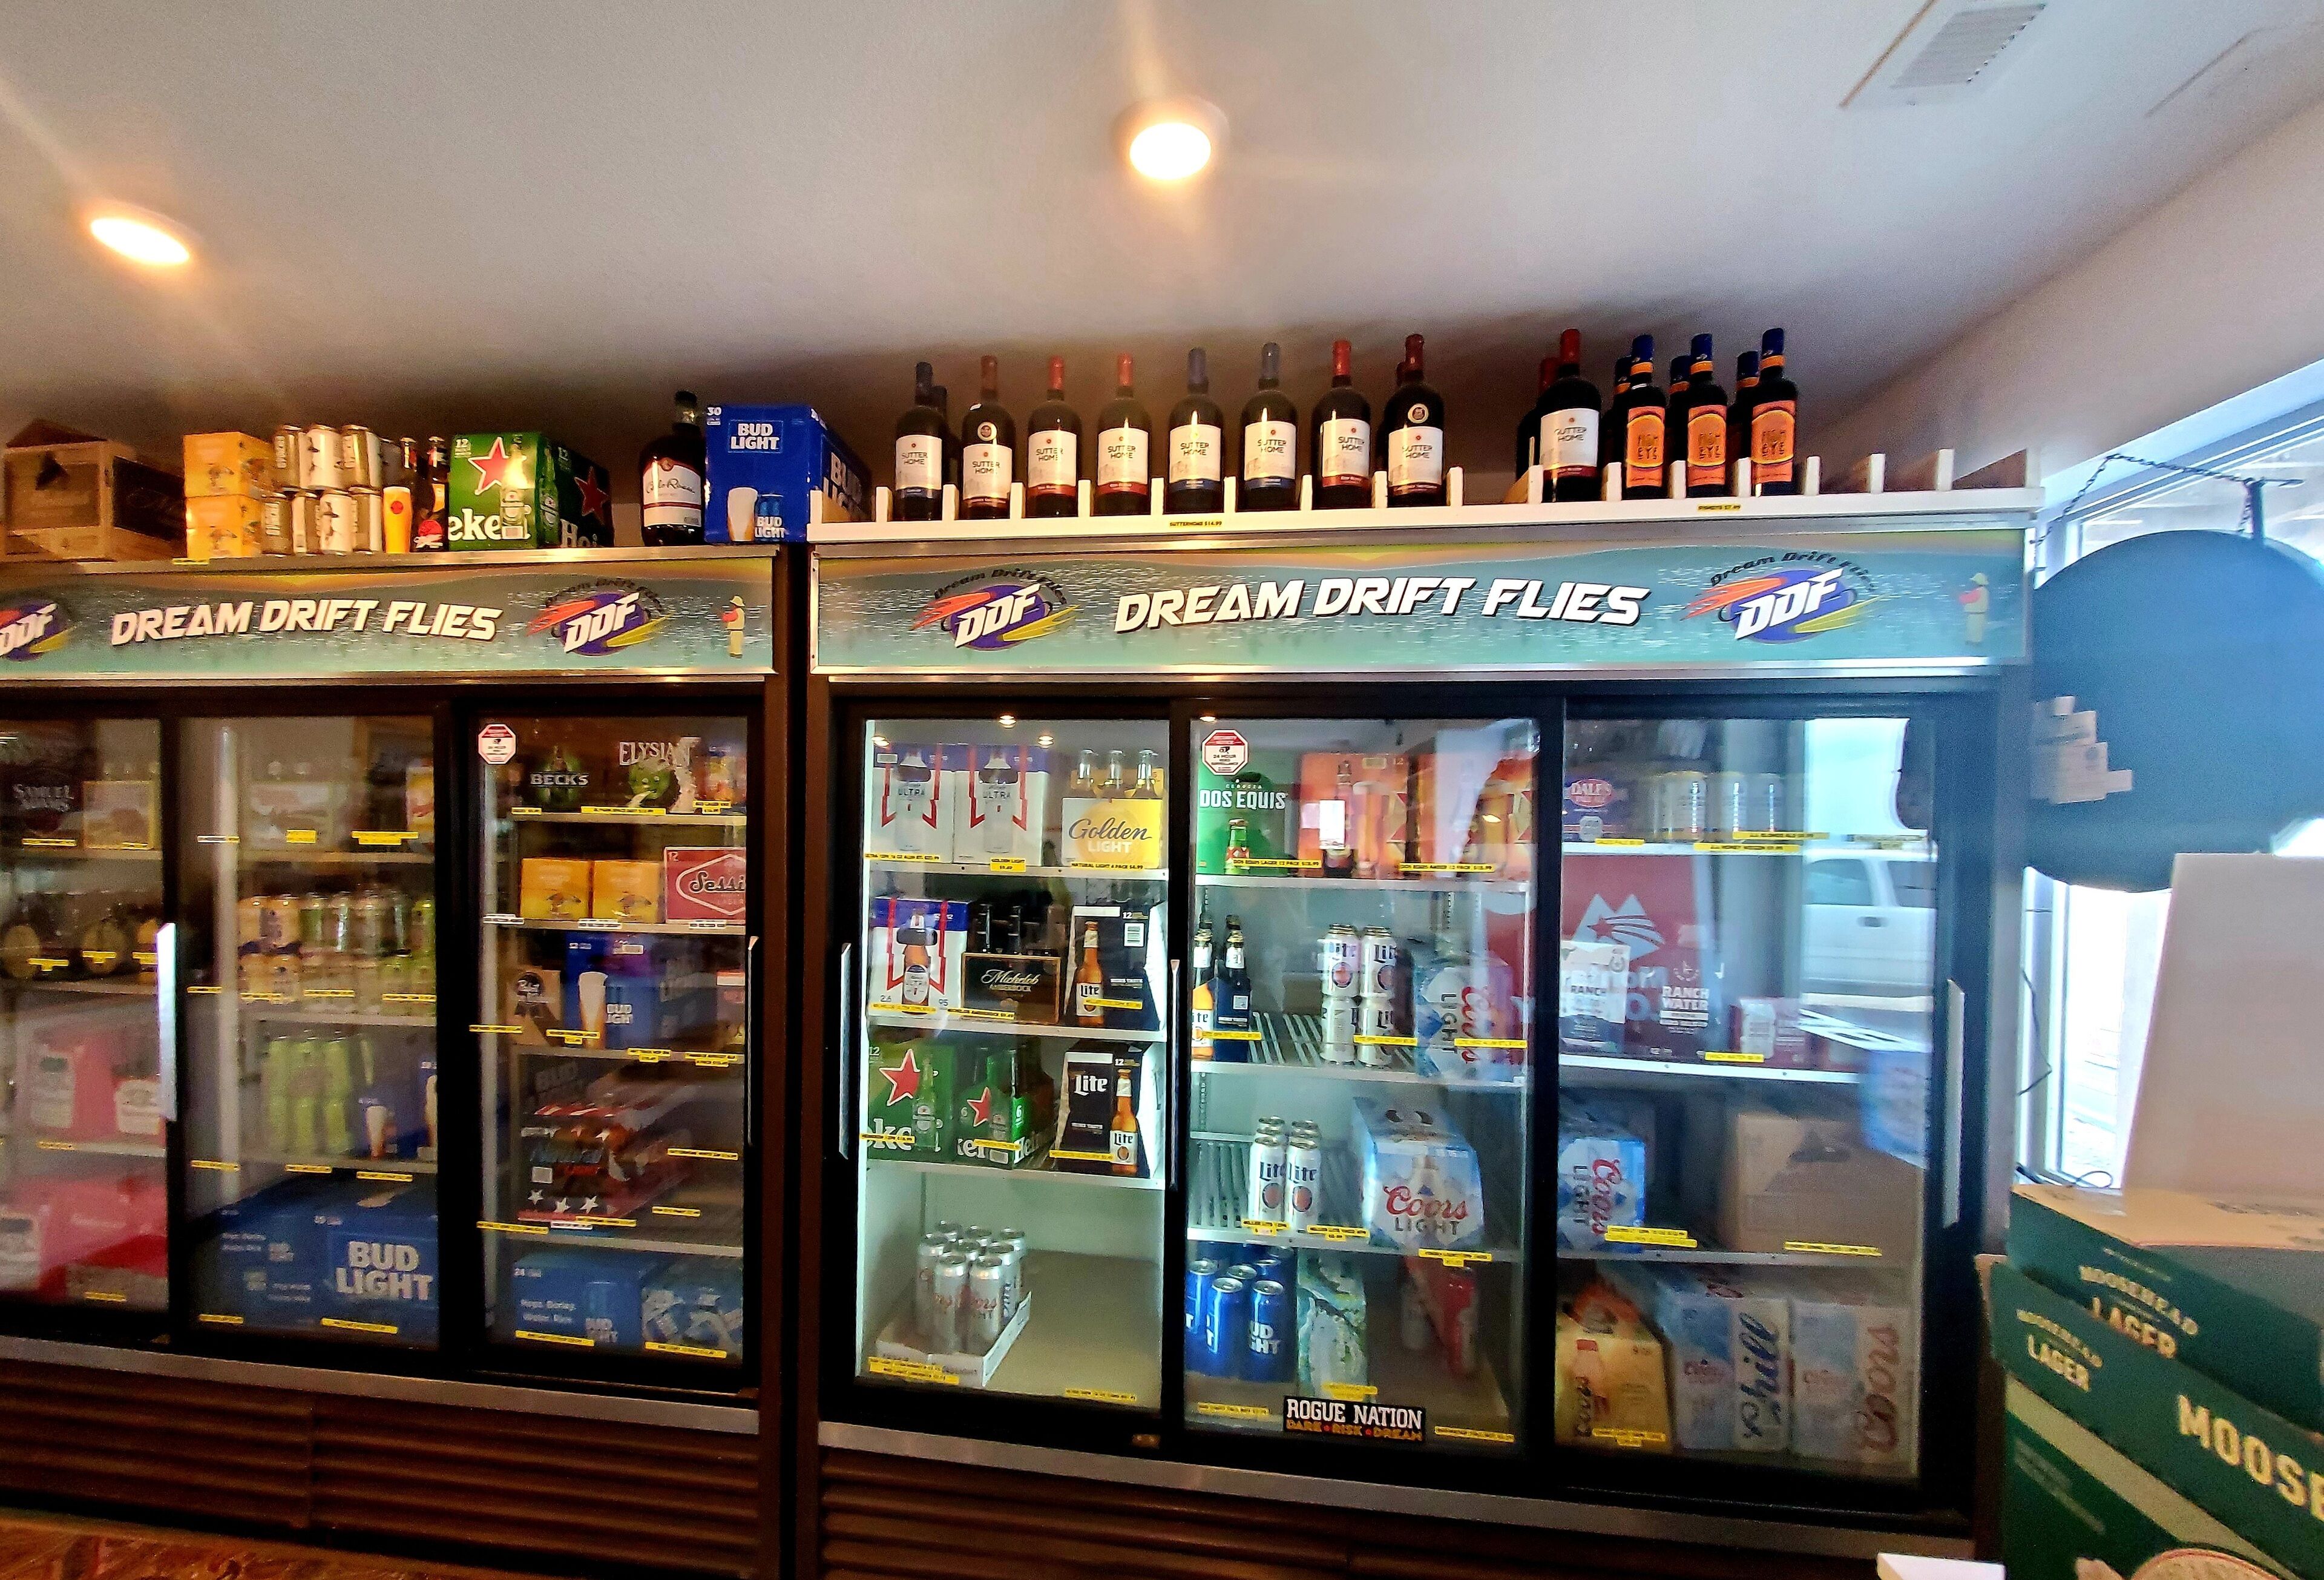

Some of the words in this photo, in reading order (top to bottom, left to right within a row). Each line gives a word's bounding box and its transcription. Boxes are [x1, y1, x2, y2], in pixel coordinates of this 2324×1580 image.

[706, 407, 722, 416] 30
[738, 423, 773, 437] BUD
[730, 436, 780, 450] LIGHT
[755, 526, 786, 538] LIGHT
[757, 516, 783, 527] BUD
[1710, 556, 1775, 587] Dream
[1781, 551, 1836, 565] Drift
[1114, 579, 1305, 634] DREAM
[1311, 576, 1477, 617] DRIFT
[1482, 578, 1652, 627] FLIES
[1734, 568, 1843, 641] DDF
[110, 601, 255, 645] DREAM
[258, 599, 380, 632] DRIFT
[381, 600, 504, 641] FLIES
[563, 591, 641, 654] DDF
[954, 583, 1042, 648] DDF
[983, 791, 1011, 799] ULTRA
[1199, 789, 1232, 808] DOS
[1236, 790, 1286, 810] EQUIS
[1069, 817, 1153, 840] Golden
[1088, 840, 1133, 854] LIGHT
[980, 969, 1041, 986] Michelob
[1080, 985, 1100, 997] Lite
[1661, 986, 1710, 999] RANCH
[1661, 998, 1709, 1010] WATER
[1441, 993, 1458, 1054] LIGHT
[868, 1047, 881, 1057] 12
[1074, 1074, 1108, 1096] Lite
[960, 1107, 967, 1118] 6
[1016, 1105, 1023, 1119] 6
[1114, 1133, 1134, 1145] Lite
[1287, 1162, 1318, 1183] Lite
[1383, 1185, 1469, 1220] Coors
[1573, 1165, 1590, 1226] LIGHT
[1592, 1158, 1623, 1237] Coors
[1394, 1216, 1460, 1236] LIGHT
[349, 1240, 421, 1272] BUD
[335, 1266, 434, 1301] LIGHT
[2027, 1334, 2090, 1393] LAGER
[1286, 1398, 1346, 1423] ROGUE
[1353, 1404, 1423, 1430] NATION
